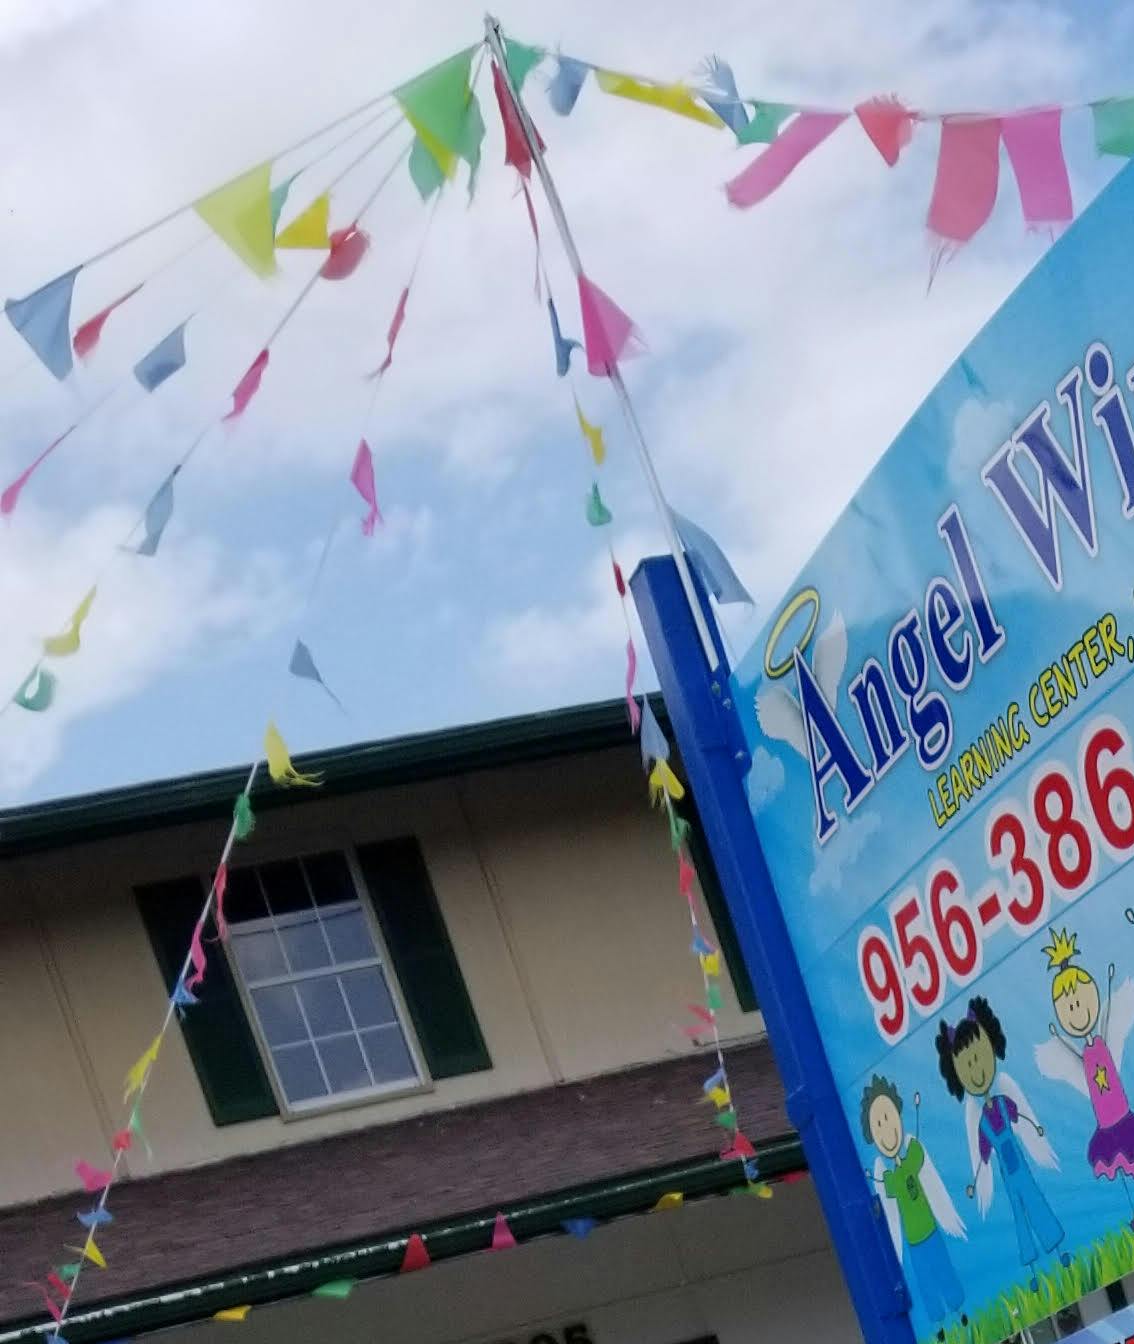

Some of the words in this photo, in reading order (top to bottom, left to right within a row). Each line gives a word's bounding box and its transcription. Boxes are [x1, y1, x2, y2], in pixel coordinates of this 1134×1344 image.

[793, 506, 1004, 842] Angel
[927, 702, 1031, 828] LEARNING
[1029, 613, 1134, 727] CENTER,
